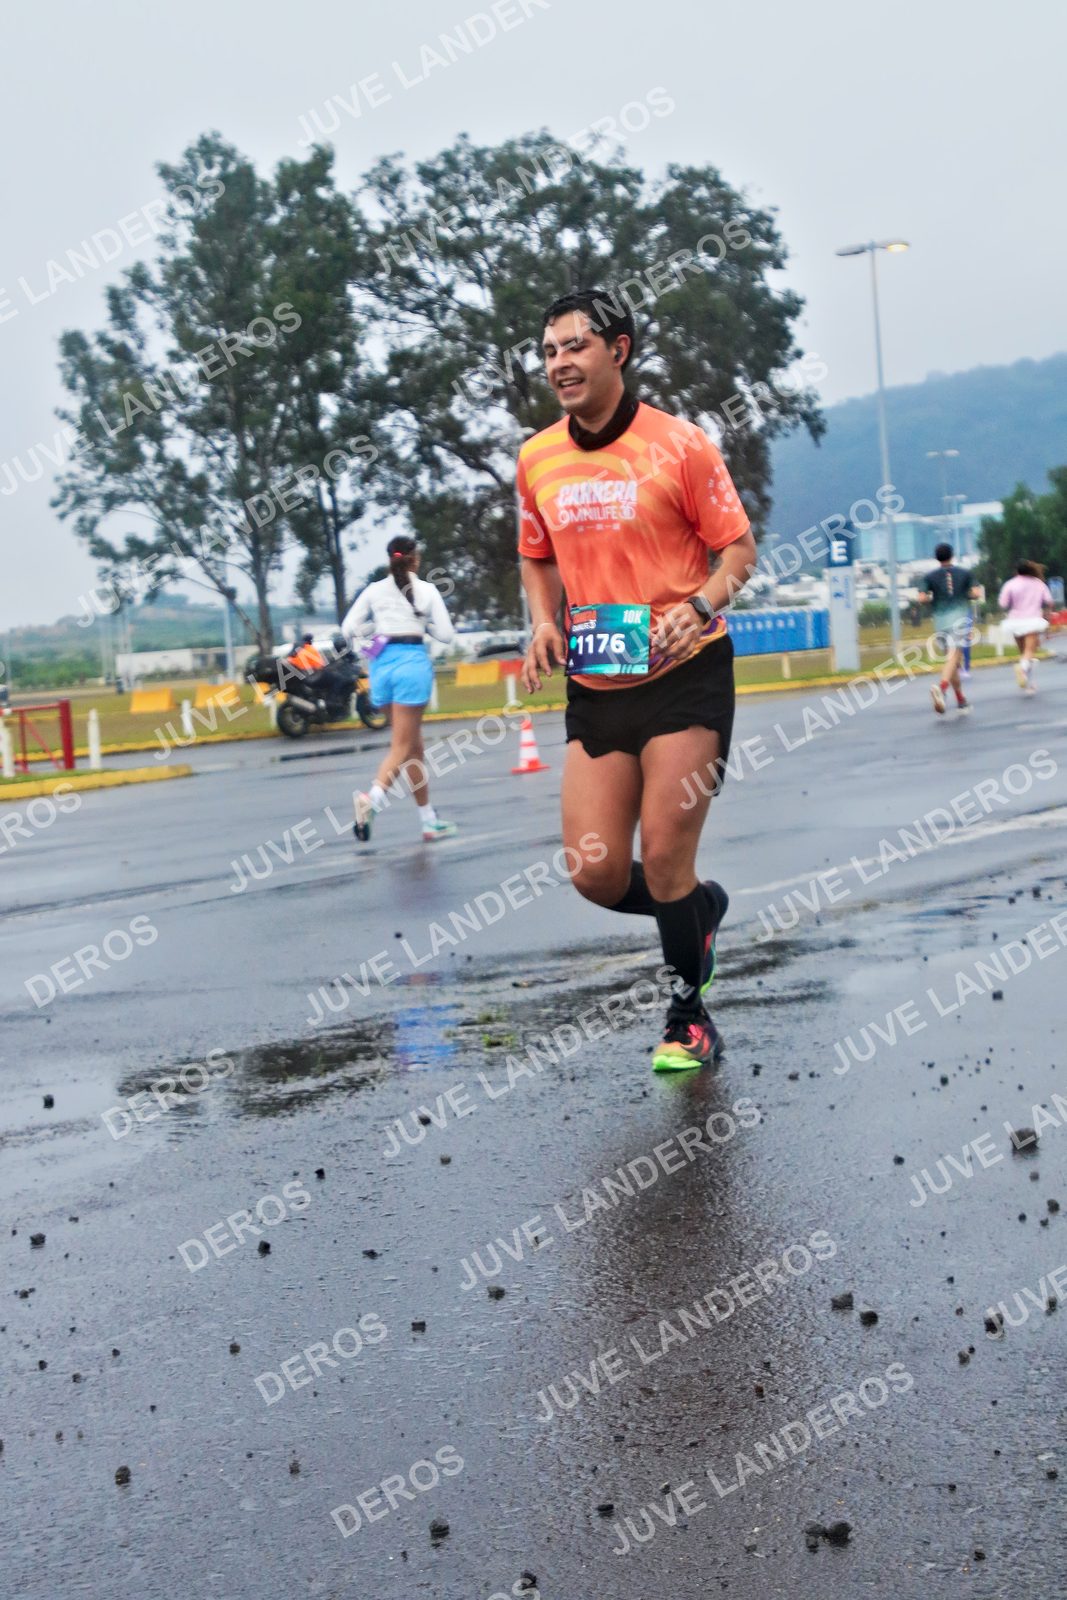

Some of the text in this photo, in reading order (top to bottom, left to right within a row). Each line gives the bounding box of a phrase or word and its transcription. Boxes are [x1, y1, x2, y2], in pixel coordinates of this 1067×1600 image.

[831, 540, 848, 562] E
[622, 609, 644, 624] 10K
[577, 633, 626, 655] 1176
